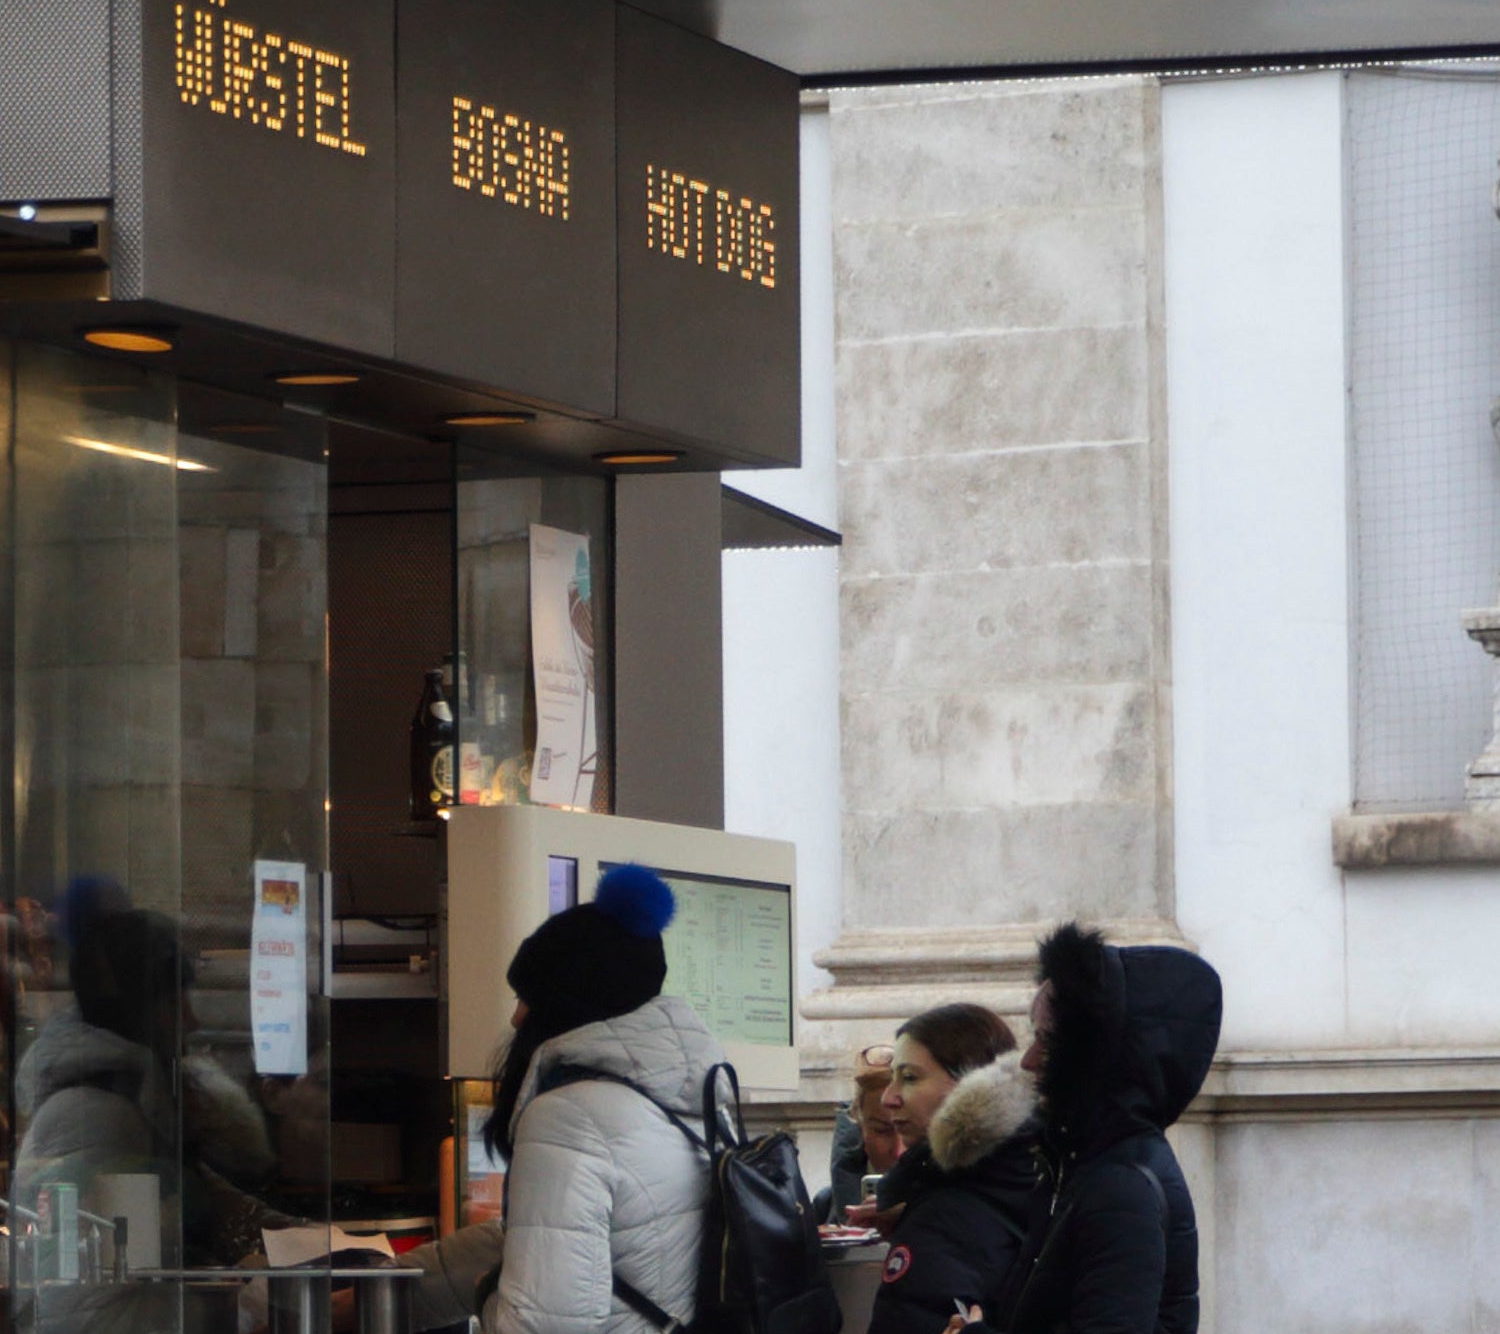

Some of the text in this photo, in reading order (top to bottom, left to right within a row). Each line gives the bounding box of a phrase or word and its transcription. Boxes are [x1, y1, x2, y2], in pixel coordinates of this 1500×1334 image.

[453, 97, 570, 222] BOSNA
[647, 165, 776, 289] HOT DOG
